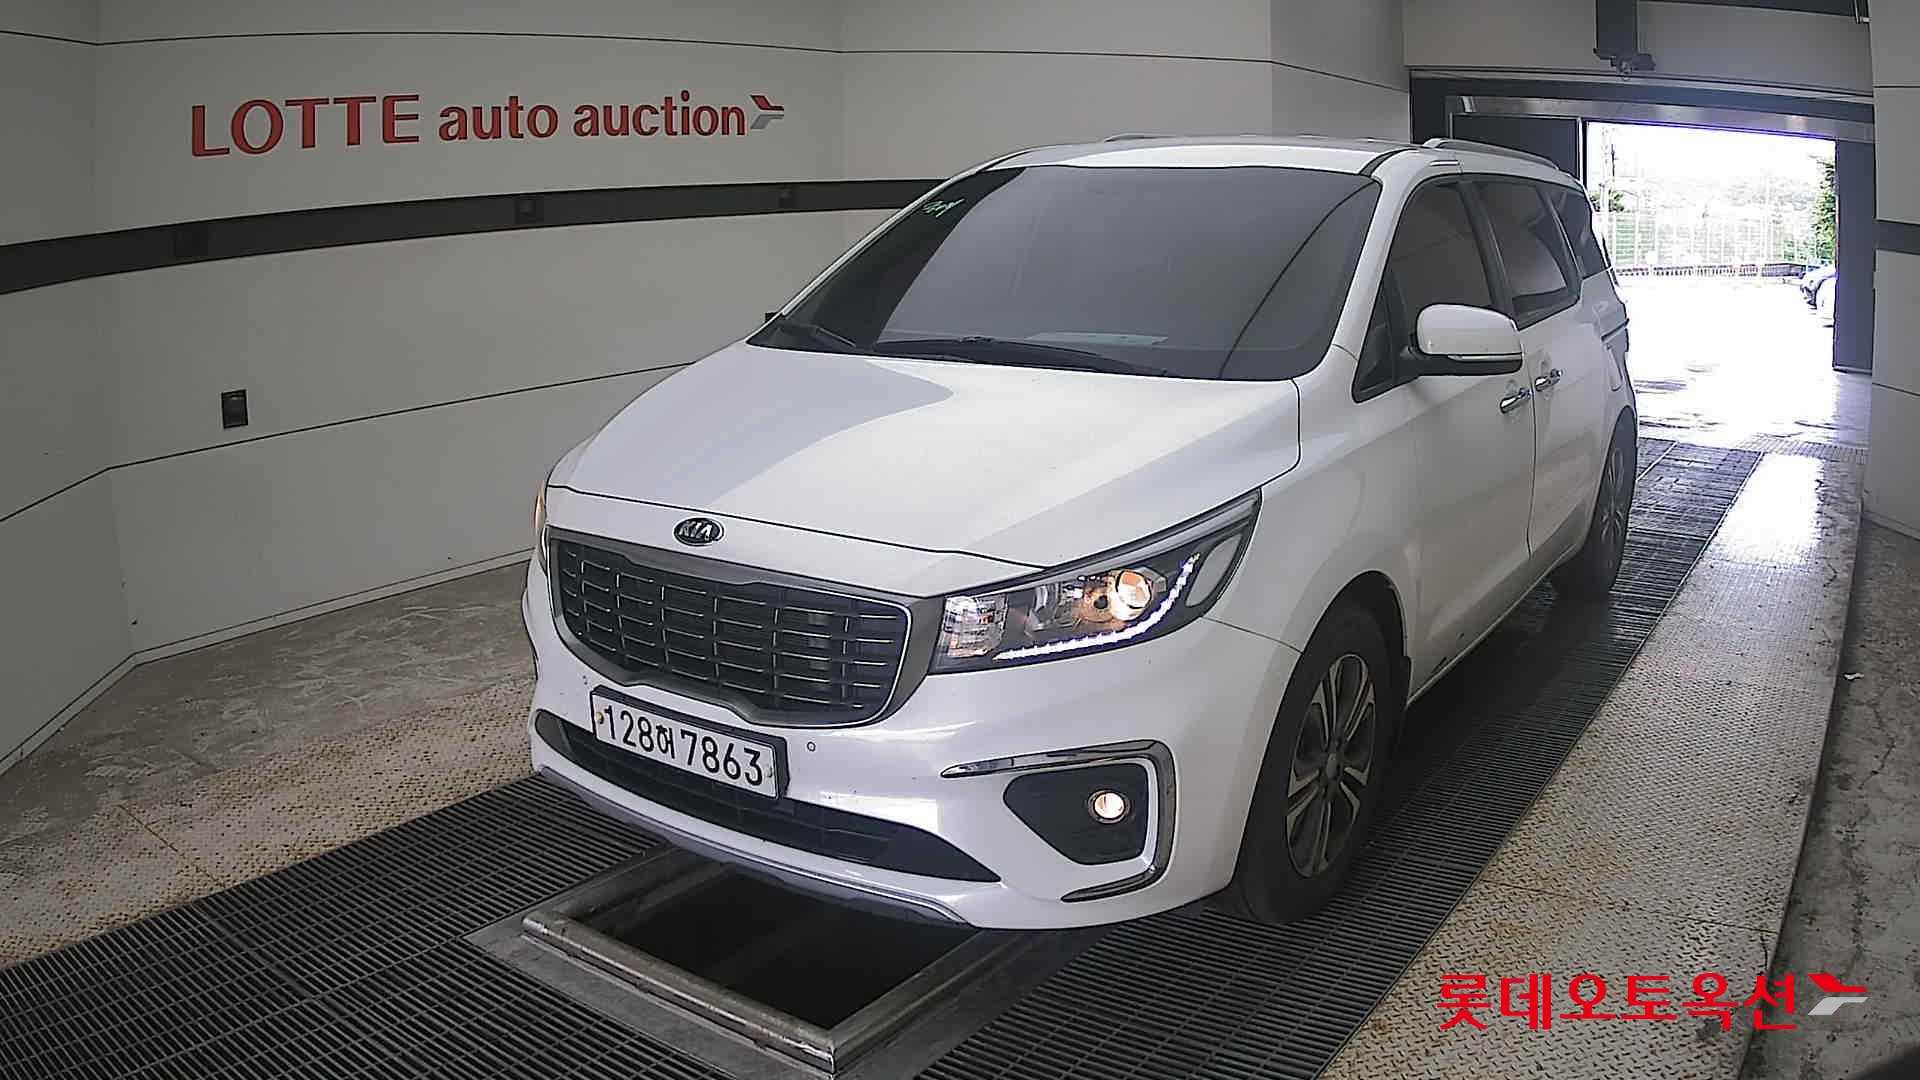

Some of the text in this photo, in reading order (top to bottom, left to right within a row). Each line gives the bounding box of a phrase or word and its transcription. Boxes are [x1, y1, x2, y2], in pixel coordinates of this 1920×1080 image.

[191, 90, 747, 158] LOTTE auto auction
[678, 520, 714, 541] KIA
